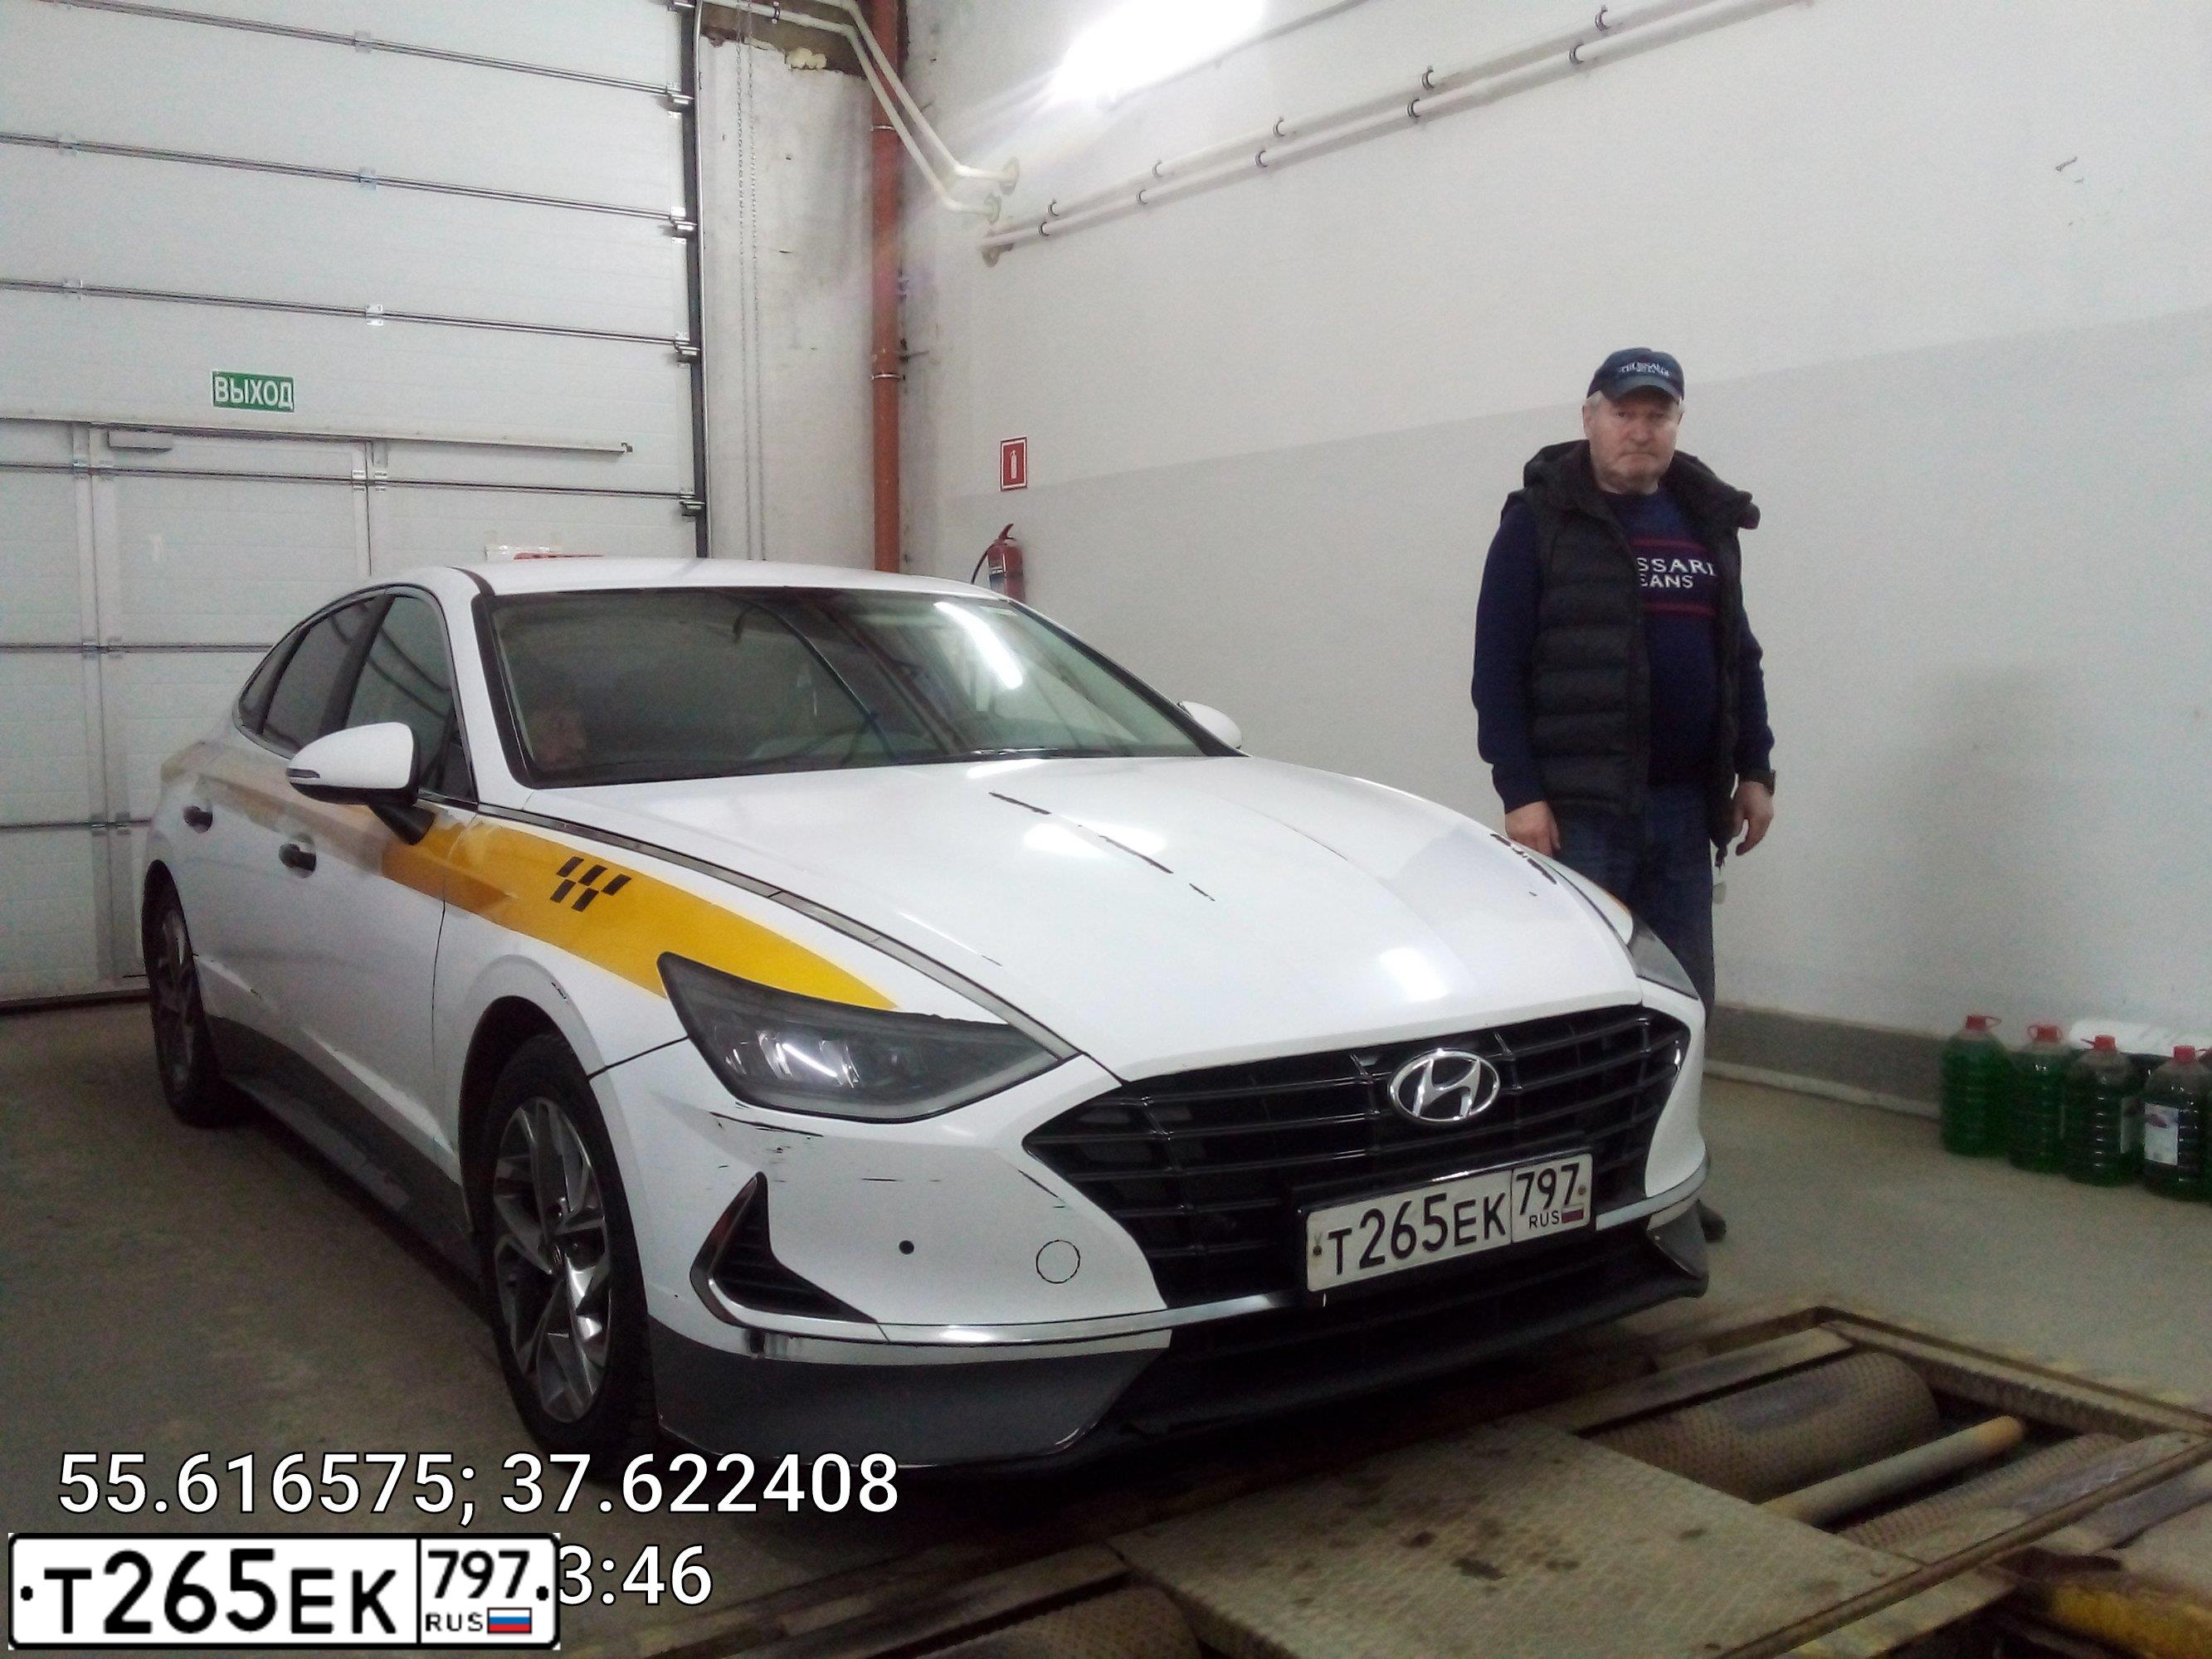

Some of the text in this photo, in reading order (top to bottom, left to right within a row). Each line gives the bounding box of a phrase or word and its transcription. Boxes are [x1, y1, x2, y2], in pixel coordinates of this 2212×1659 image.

[214, 376, 294, 409] ВЫХОД
[1328, 1162, 1581, 1276] T265EK 797
[1528, 1210, 1561, 1230] RUS
